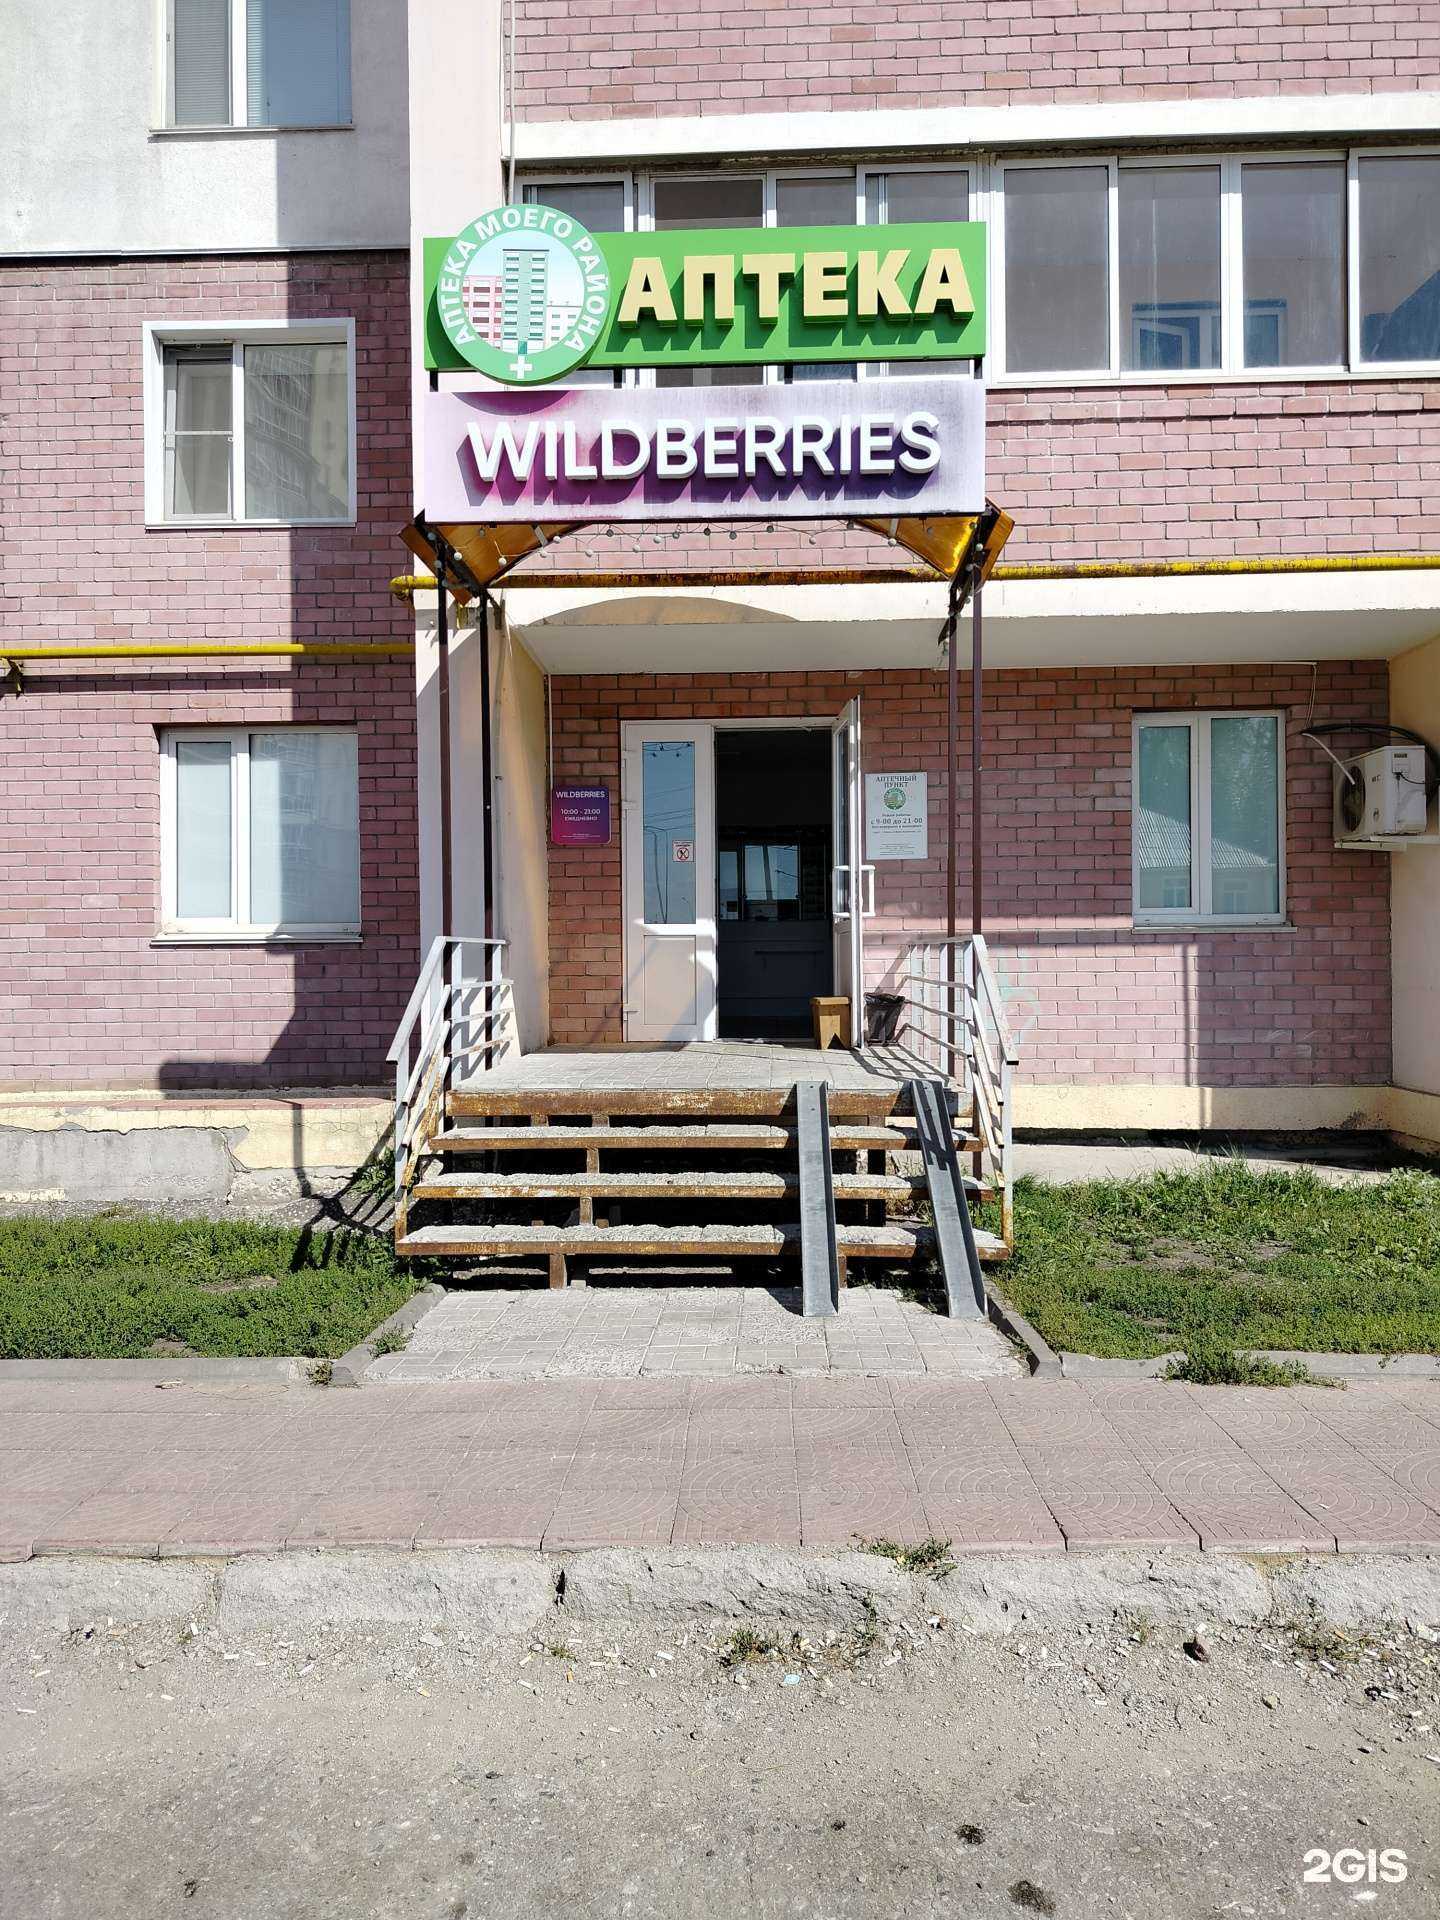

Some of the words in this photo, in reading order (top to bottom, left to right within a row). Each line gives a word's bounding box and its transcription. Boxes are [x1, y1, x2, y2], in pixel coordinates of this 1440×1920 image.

[441, 238, 477, 346] АПТЕКА
[474, 207, 573, 241] МОЕГО
[563, 236, 609, 352] РАЙОНА
[618, 247, 975, 326] АПТЕКА
[467, 410, 942, 482] WILDBERRIES
